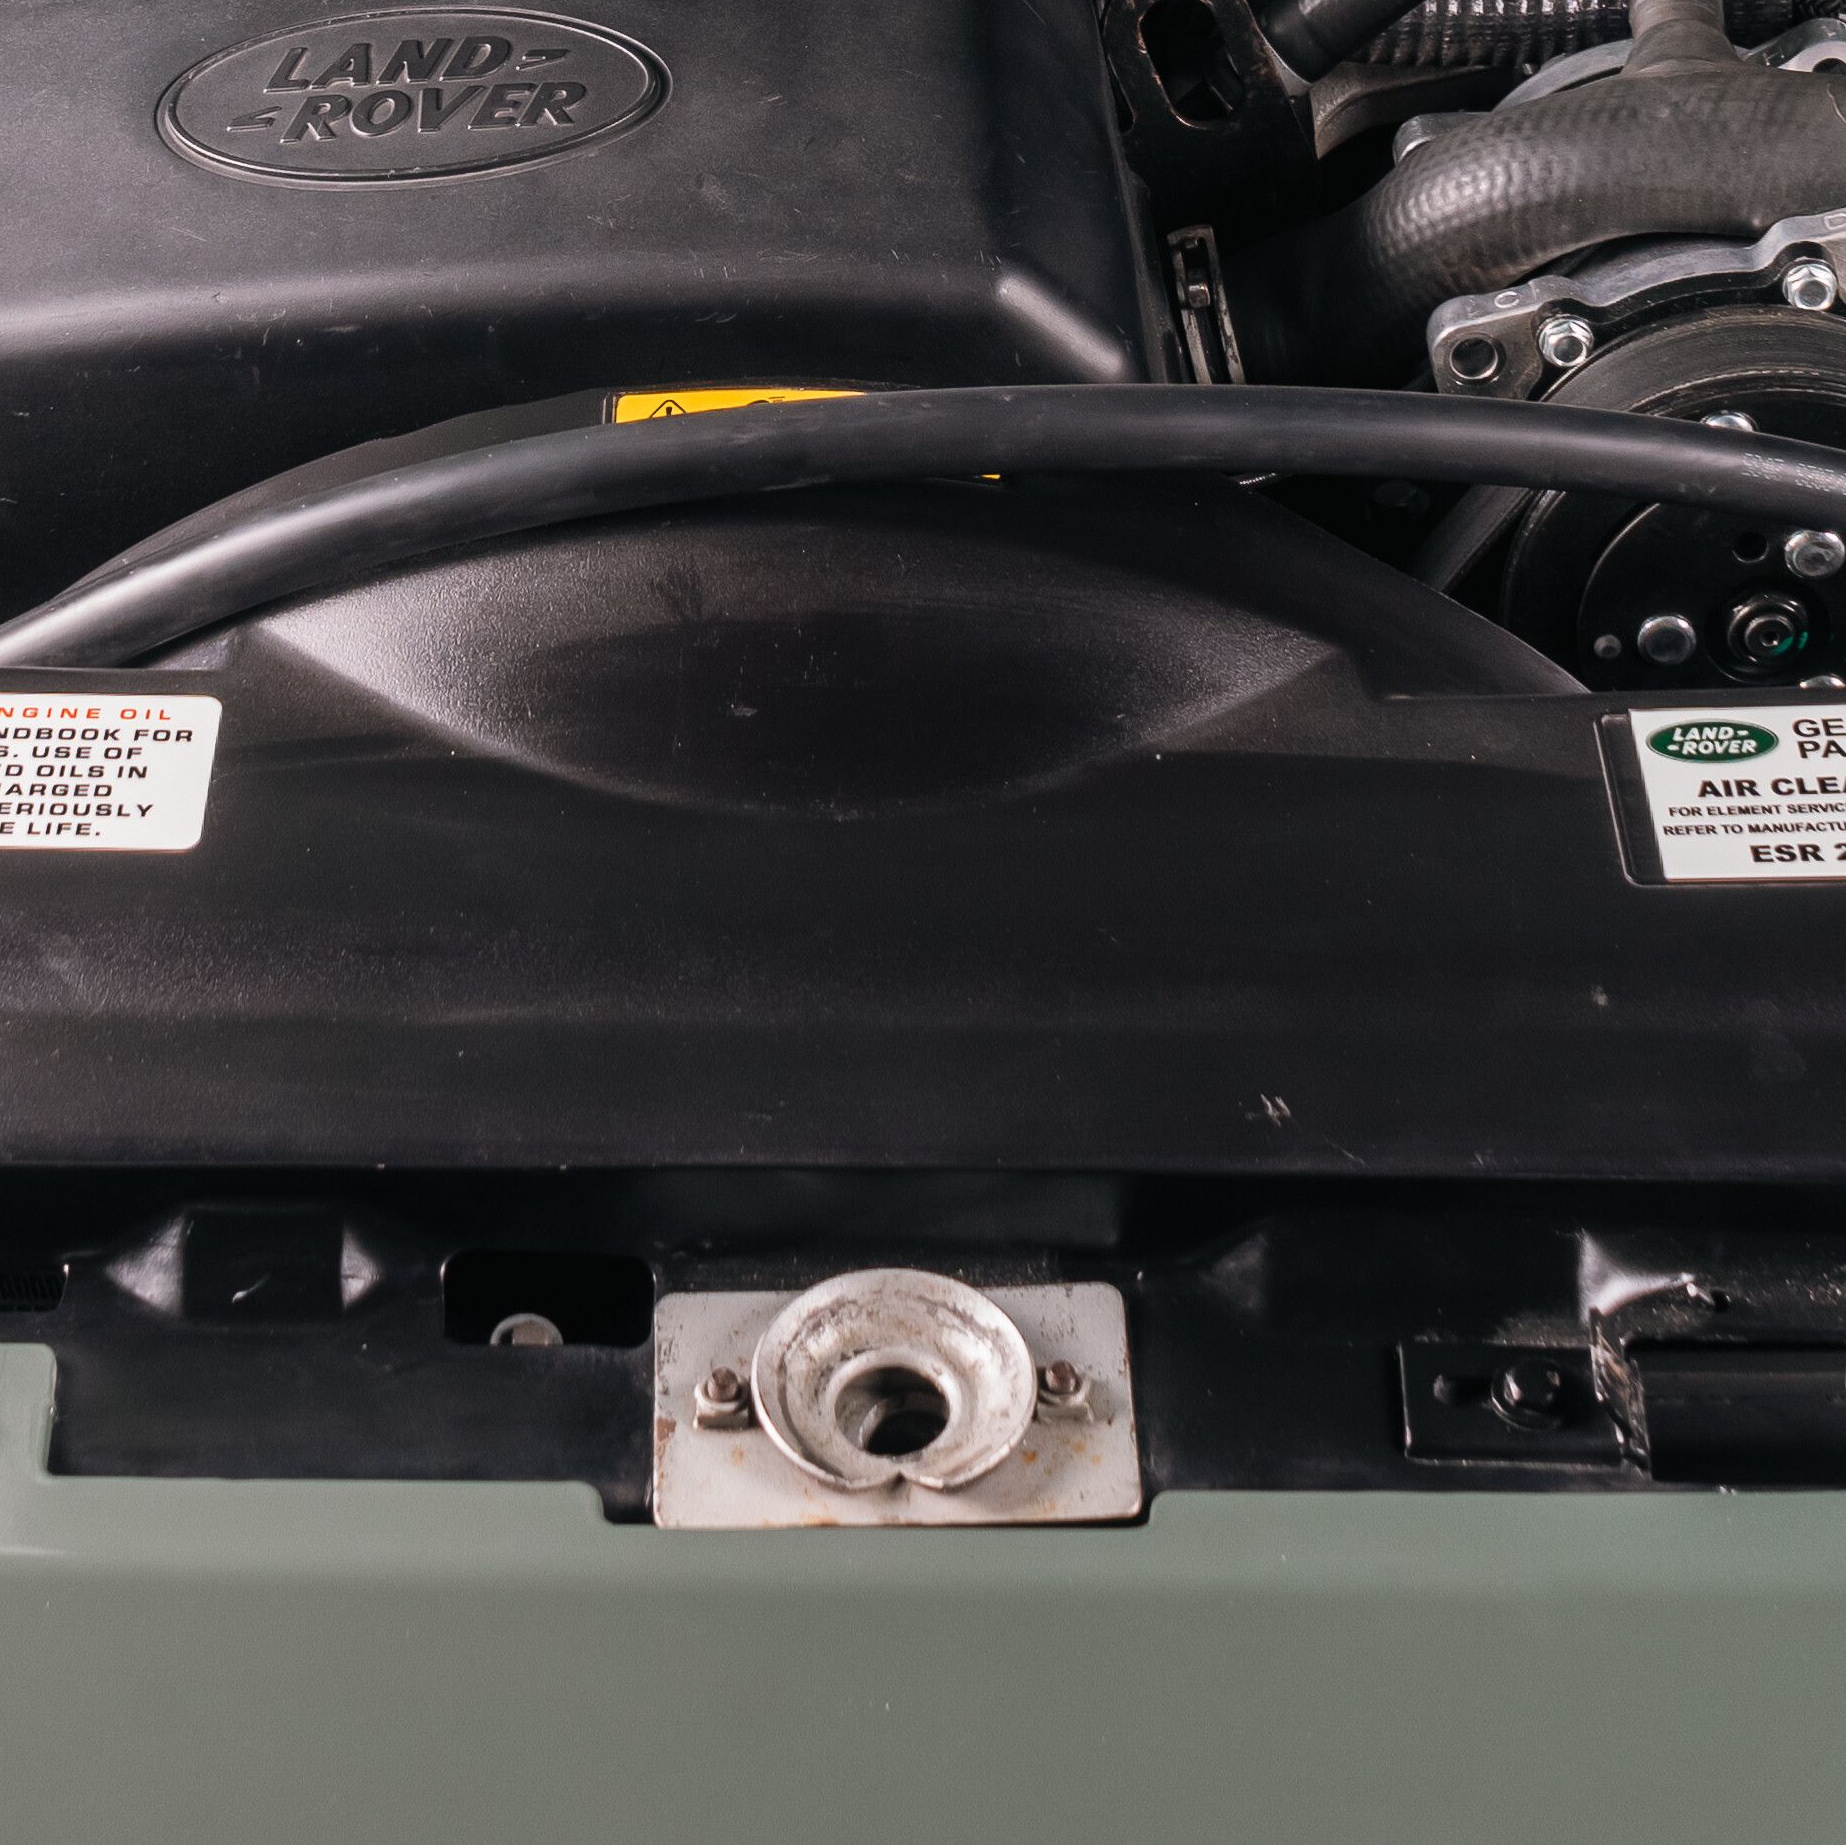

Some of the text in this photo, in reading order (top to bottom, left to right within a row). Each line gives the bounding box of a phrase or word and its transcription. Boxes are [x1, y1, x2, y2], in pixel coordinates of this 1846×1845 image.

[119, 708, 172, 721] OIL
[133, 729, 194, 742] FOR
[31, 746, 93, 759] USE
[103, 746, 144, 760] OF
[36, 765, 106, 778] OILS
[117, 765, 149, 779] IN
[1697, 778, 1762, 798] AIR
[1668, 805, 1703, 818] FOR
[1706, 803, 1782, 816] ELEMENT
[27, 821, 102, 837] LIFE.
[1662, 823, 1718, 836] REFER
[1721, 823, 1744, 834] TO
[1749, 843, 1824, 864] ESR
